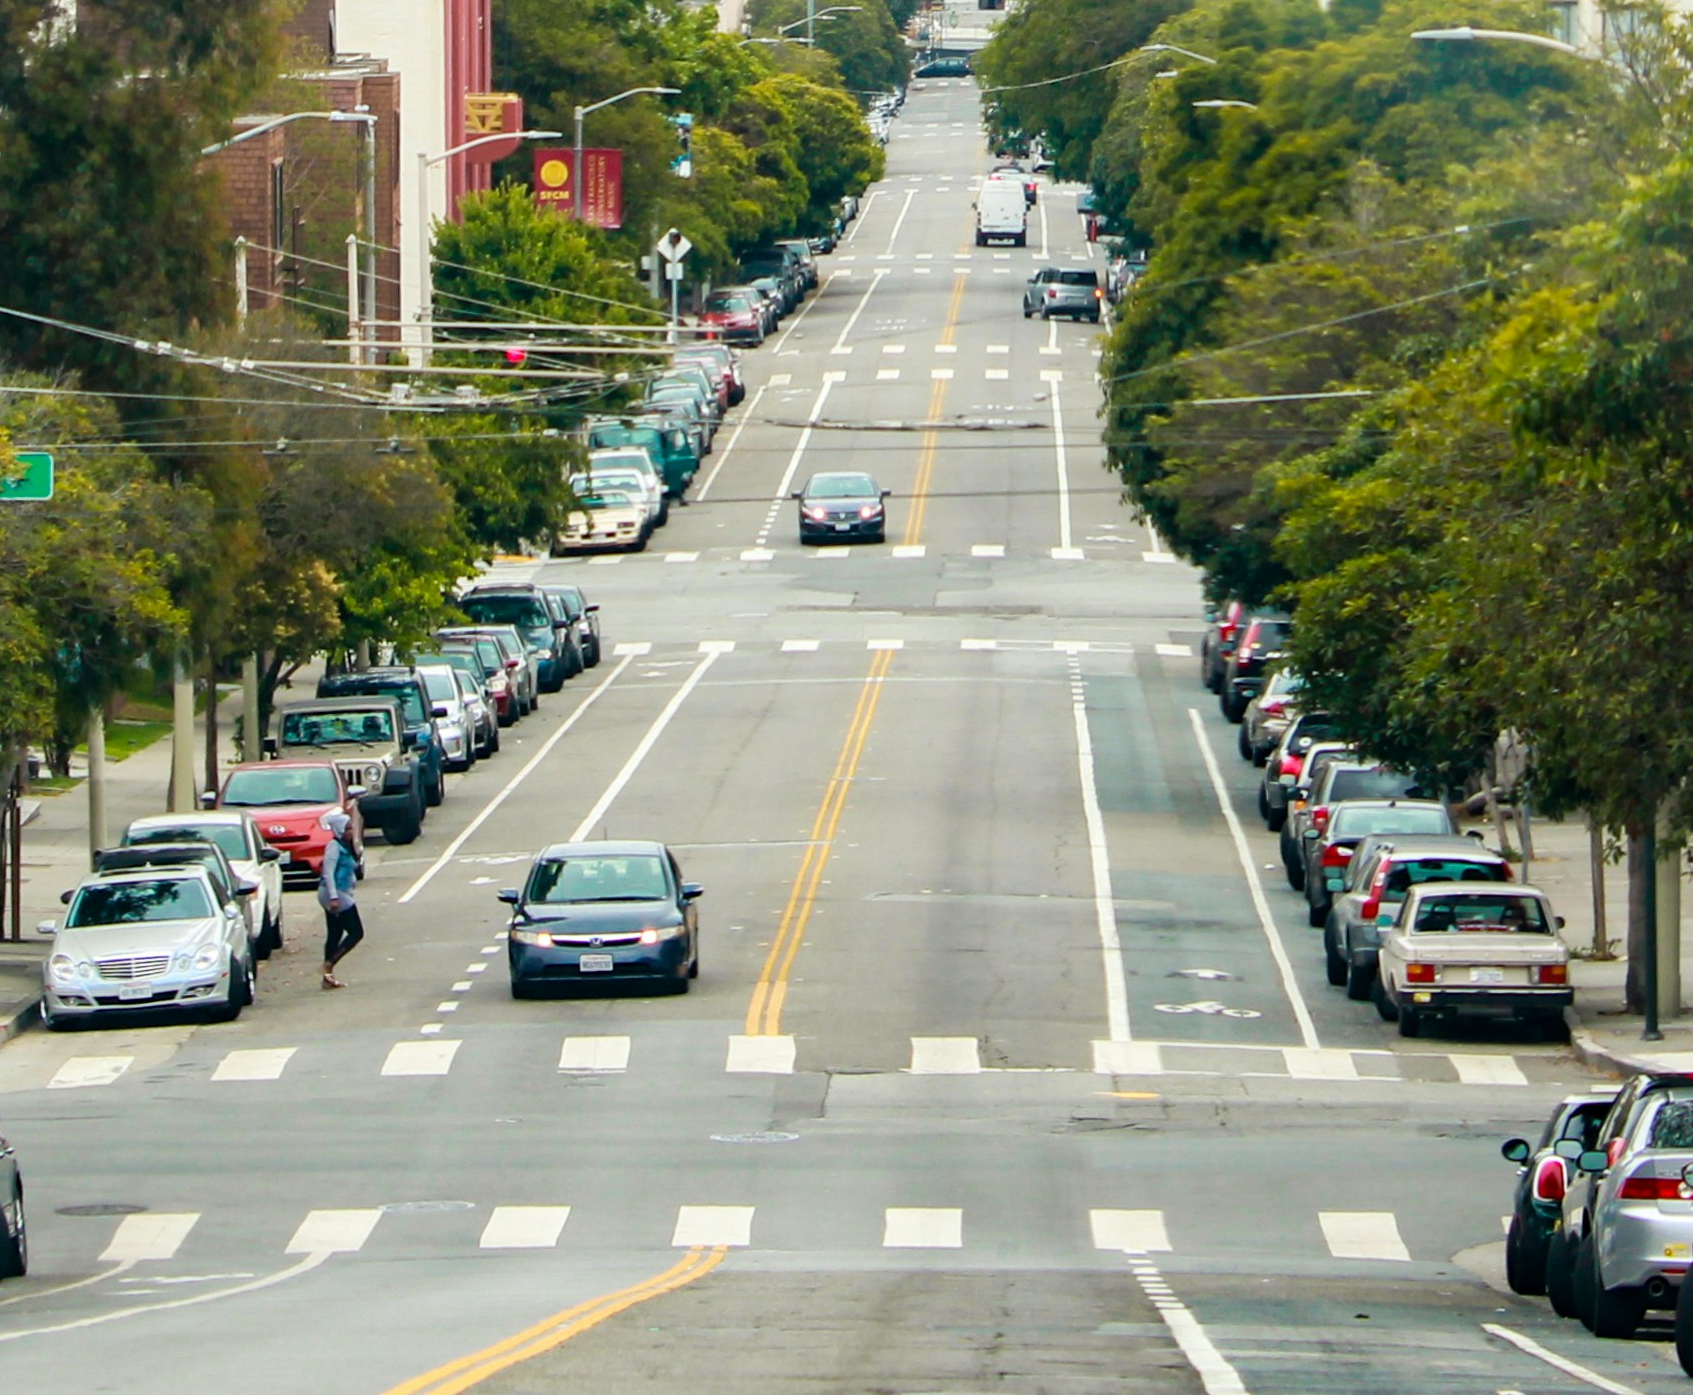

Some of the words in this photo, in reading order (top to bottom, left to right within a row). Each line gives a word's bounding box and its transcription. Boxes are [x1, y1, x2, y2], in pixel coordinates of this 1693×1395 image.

[540, 190, 570, 200] SFCM
[588, 155, 596, 203] FRANCISCO
[597, 156, 606, 223] CONSERVATORY
